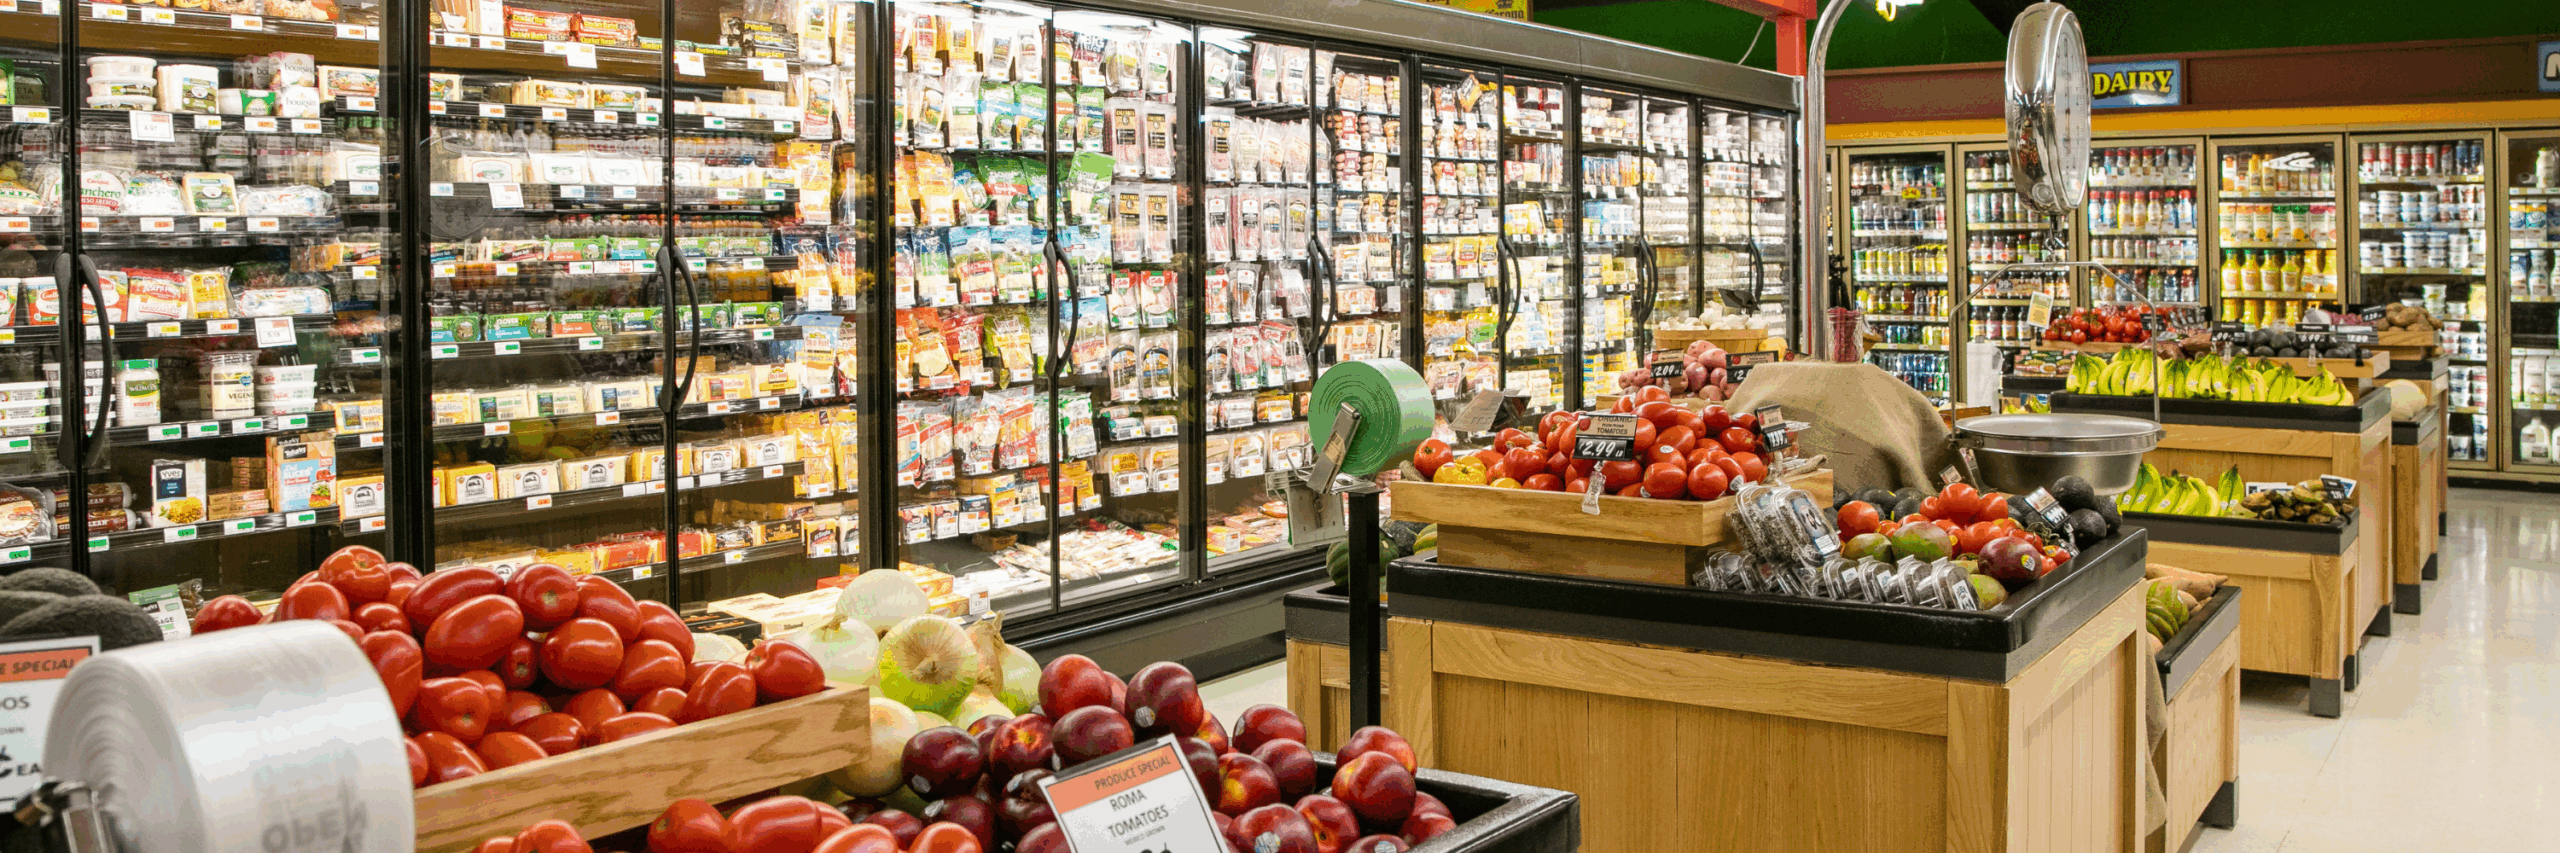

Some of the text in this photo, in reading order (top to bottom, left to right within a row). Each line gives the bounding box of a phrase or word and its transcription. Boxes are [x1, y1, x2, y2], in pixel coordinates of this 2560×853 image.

[285, 62, 312, 73] boursin
[2092, 70, 2173, 95] DAIRY
[286, 97, 316, 107] boursin
[81, 187, 121, 199] anchero
[553, 241, 574, 249] CLOVER
[620, 239, 639, 247] CLOVER
[563, 313, 583, 321] CLOVER
[431, 320, 443, 328] VER
[496, 318, 518, 326] CLOVER
[1598, 416, 1633, 424] ORGANIC
[1597, 427, 1628, 435] TOMATOES
[284, 446, 307, 457] Tofurky
[161, 471, 181, 479] Yves
[158, 616, 174, 625] SAGE
[1094, 755, 1172, 791] PRODUCE SPECIAL
[1109, 789, 1147, 812] ROMA
[1107, 805, 1169, 839] TOMATOES
